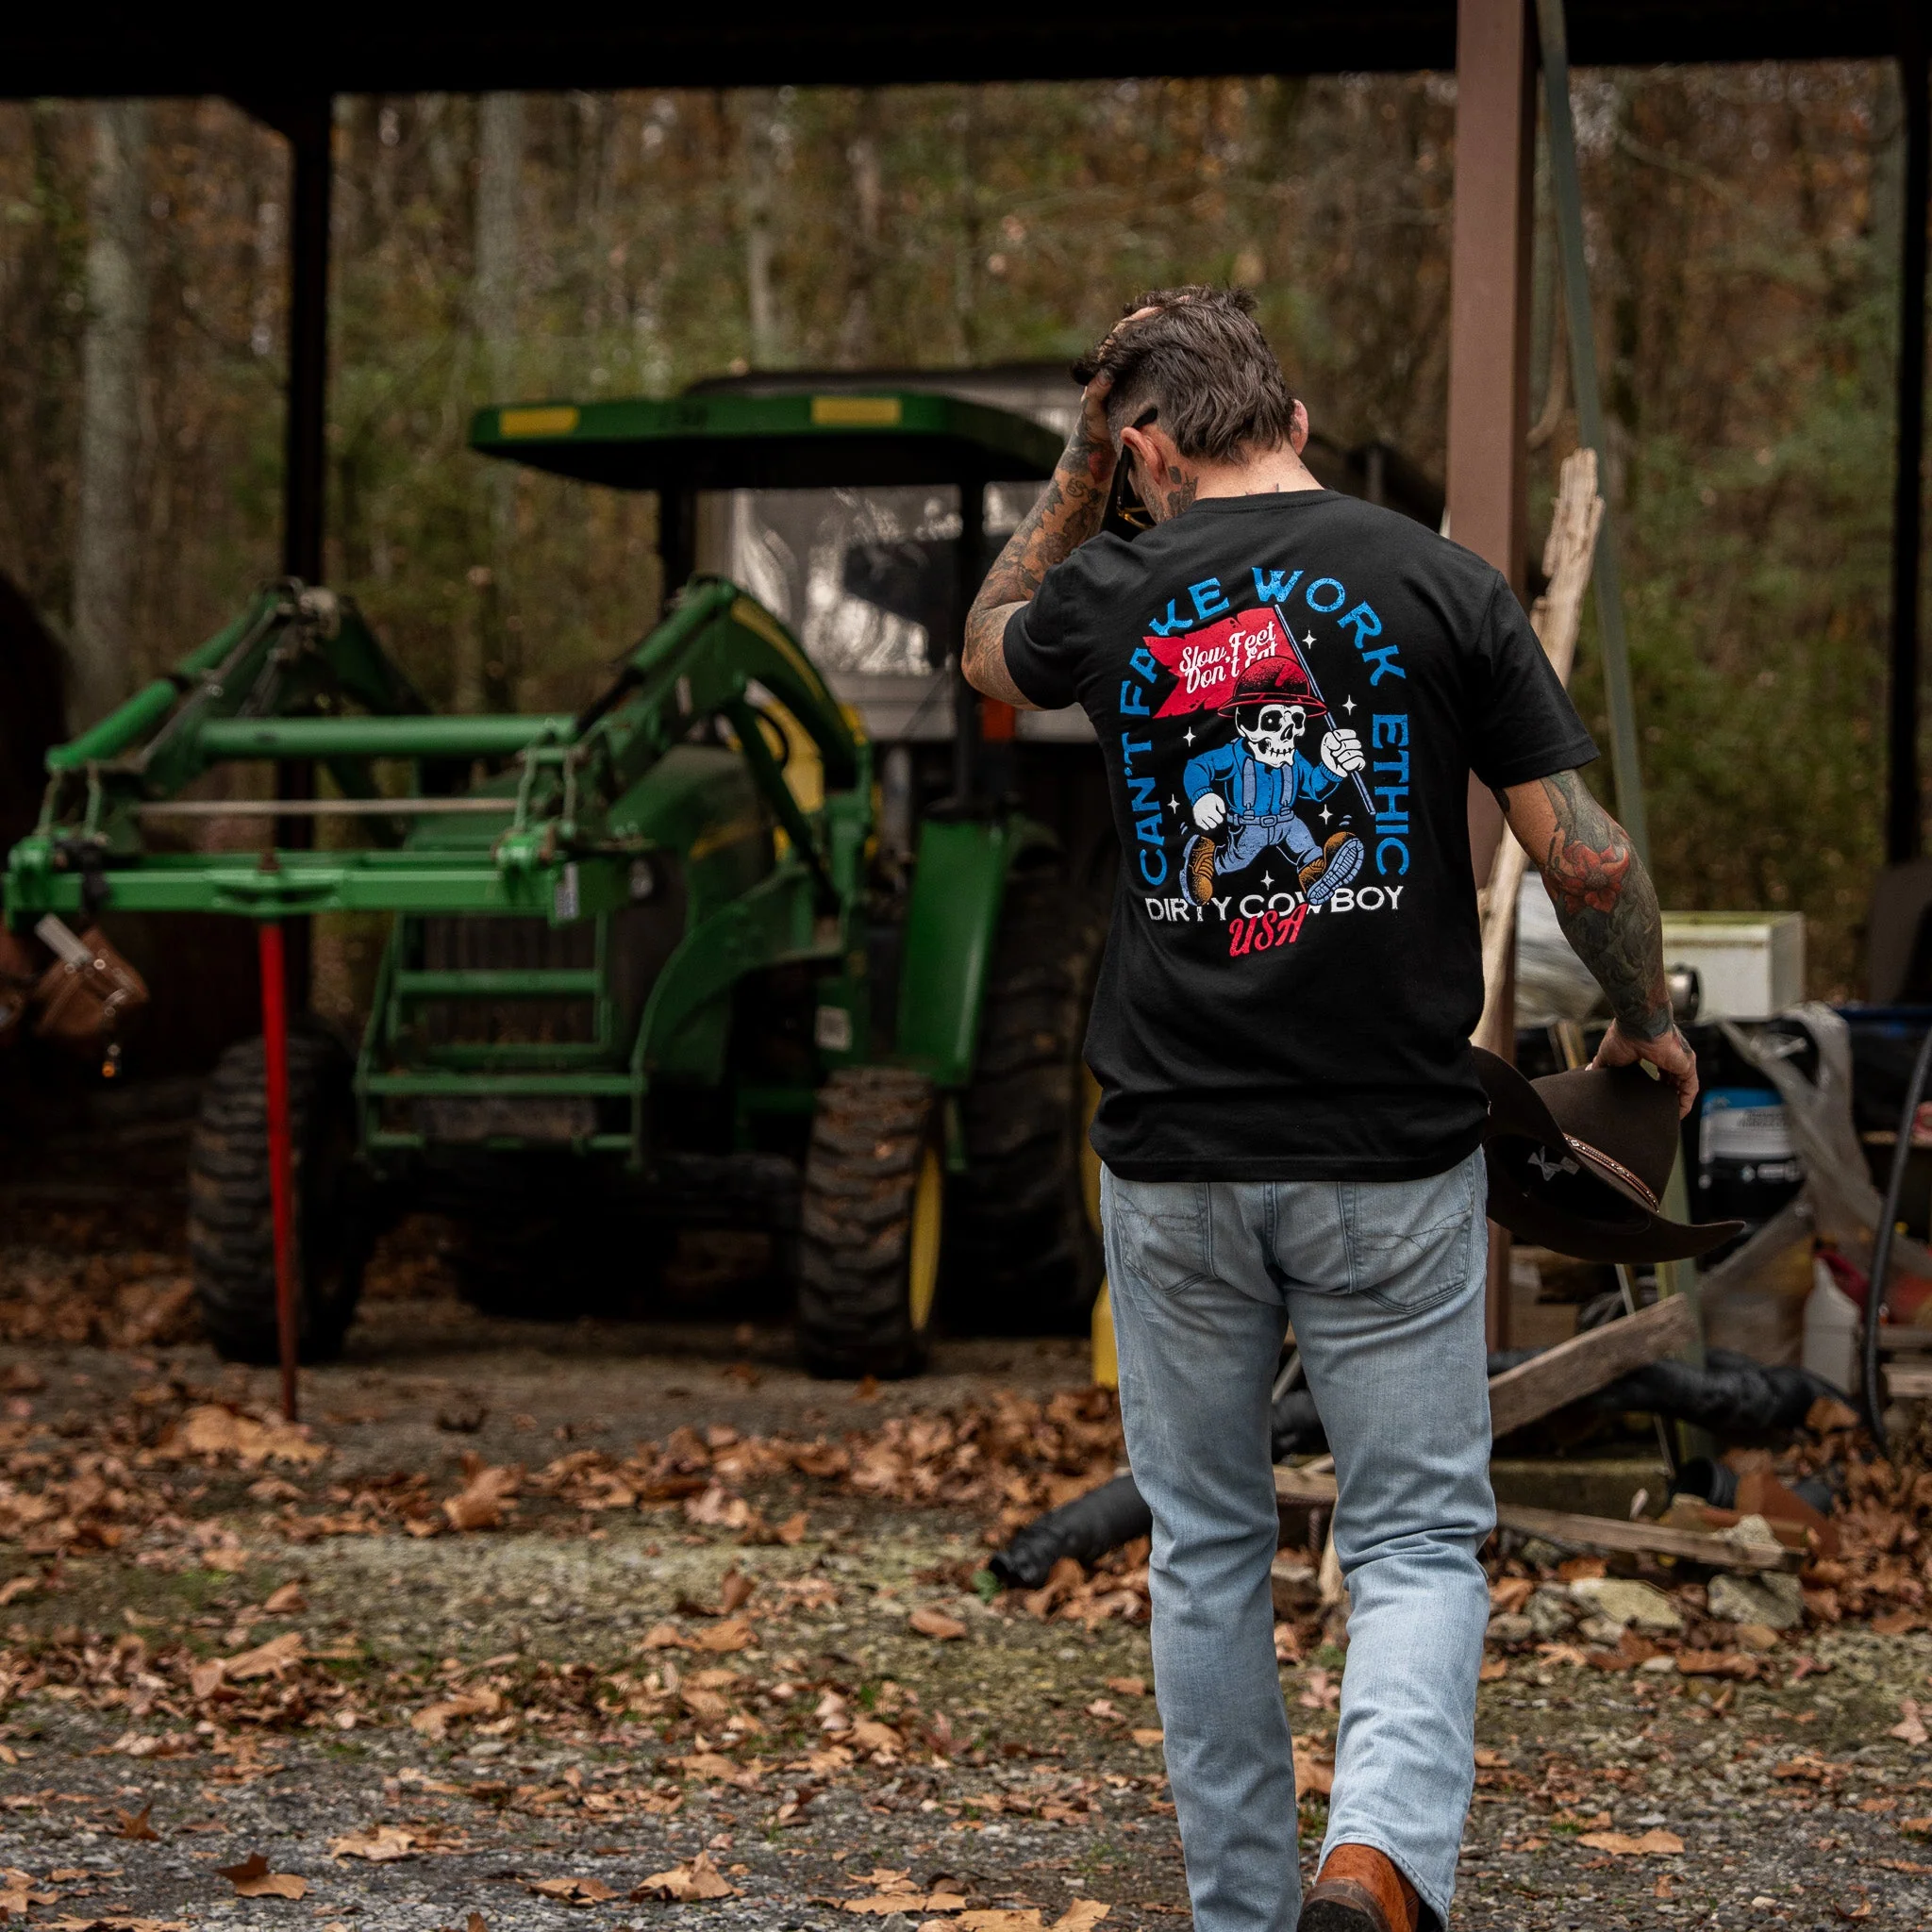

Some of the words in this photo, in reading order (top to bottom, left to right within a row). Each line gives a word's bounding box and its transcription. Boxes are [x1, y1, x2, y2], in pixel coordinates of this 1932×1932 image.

[1120, 576, 1231, 716] FAKE
[1179, 645, 1227, 673] Slow
[1228, 621, 1276, 657] Feet
[1185, 655, 1241, 694] Don't
[1252, 566, 1407, 687] WORK
[1121, 731, 1168, 886] CAN'T
[1372, 713, 1410, 876] ETHIC
[1228, 903, 1308, 958] USA
